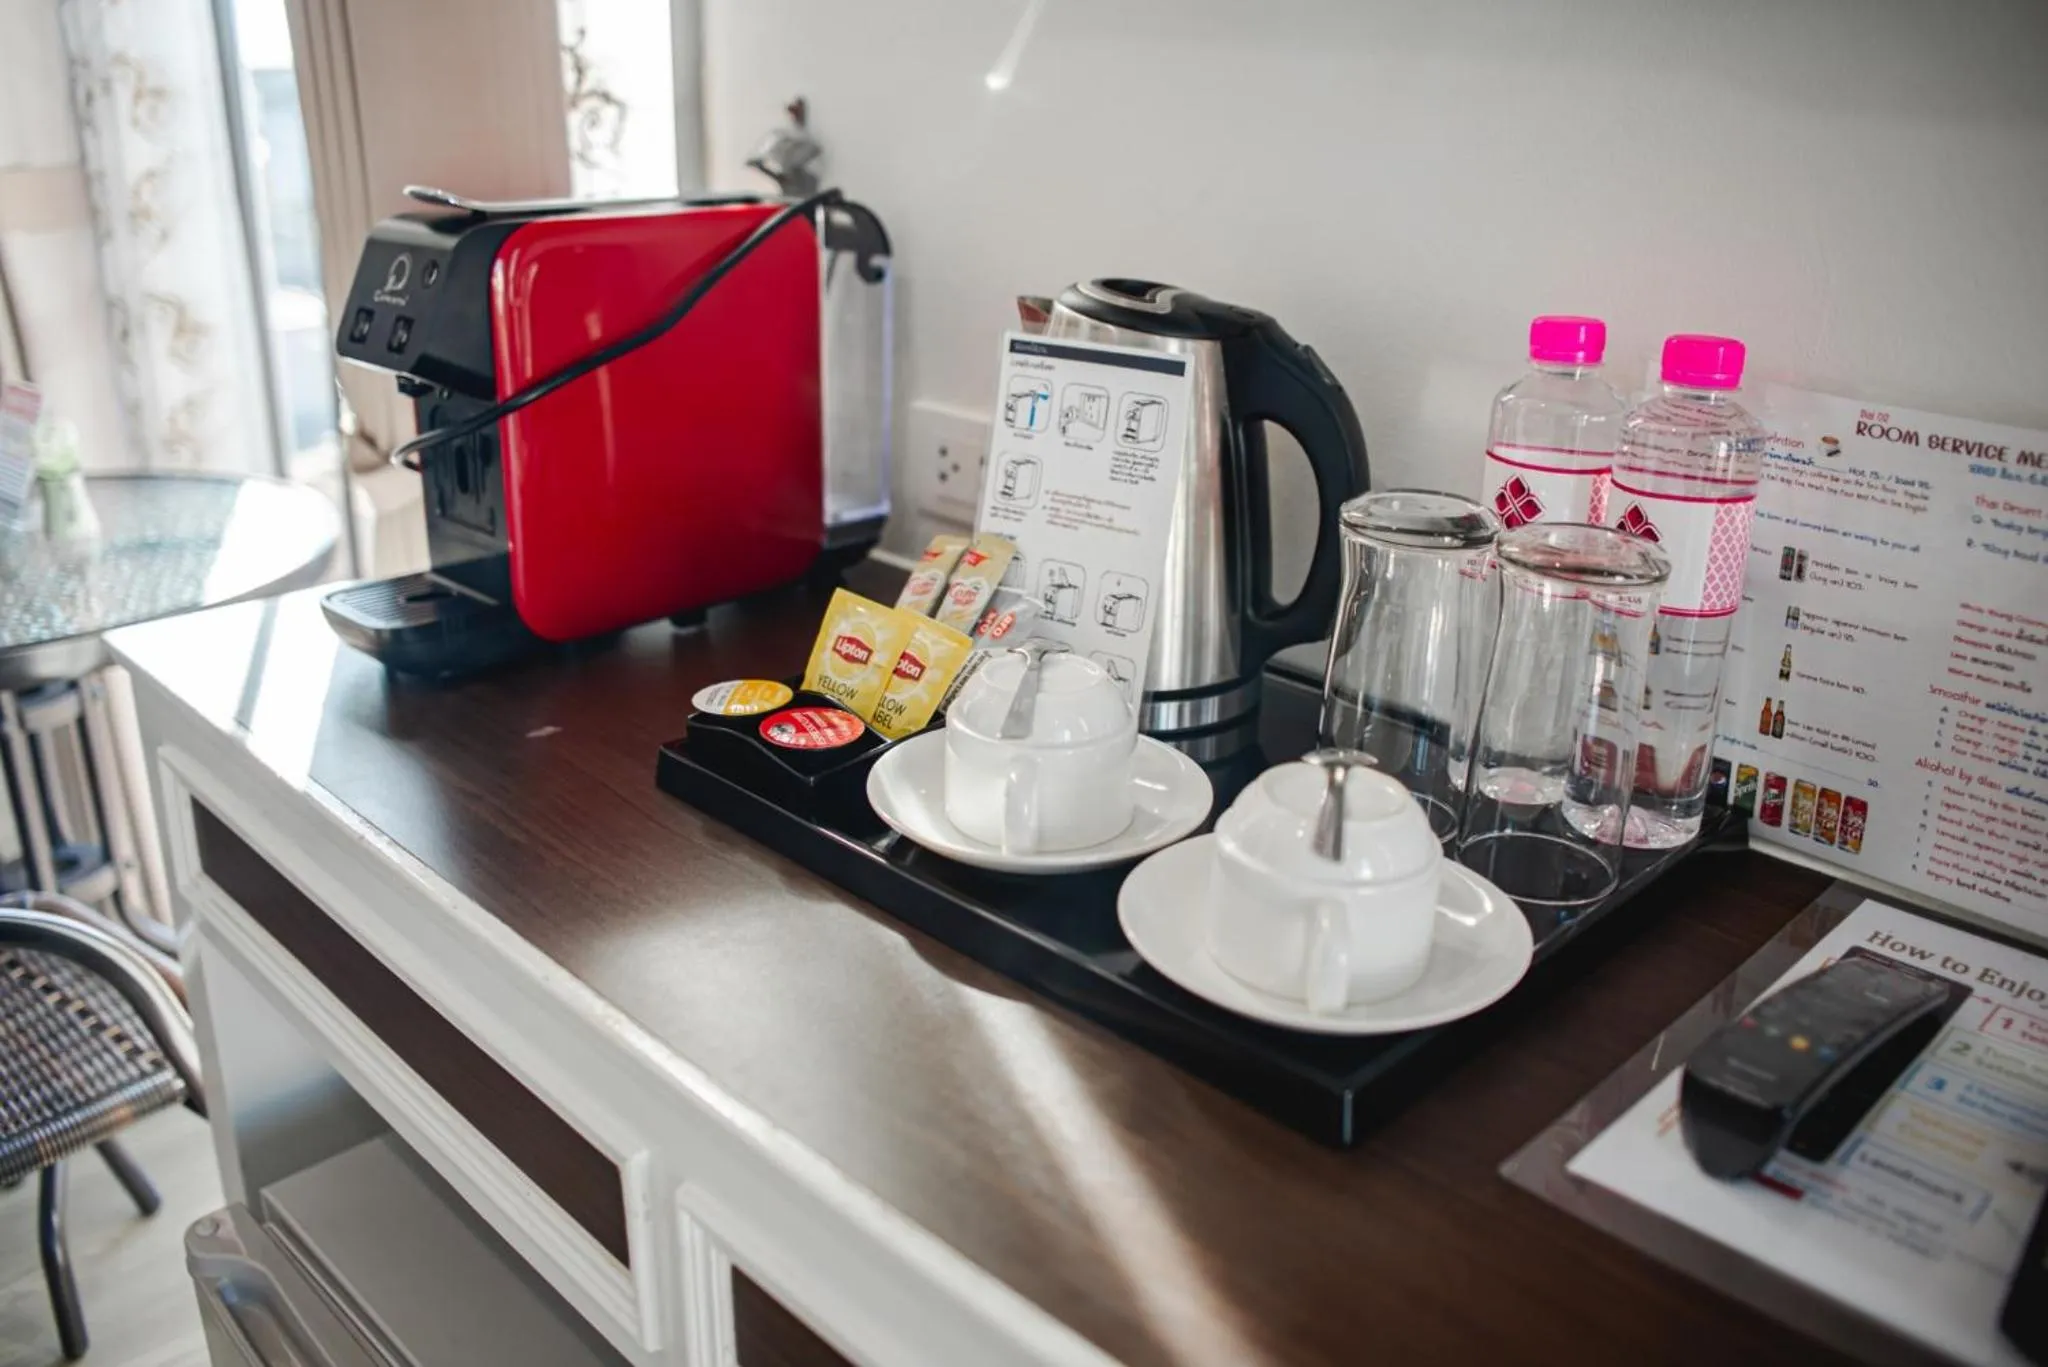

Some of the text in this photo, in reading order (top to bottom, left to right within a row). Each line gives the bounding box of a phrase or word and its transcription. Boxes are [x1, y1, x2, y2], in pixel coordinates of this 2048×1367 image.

[1856, 421, 1919, 447] ROOM
[1928, 434, 2010, 463] SERVICE
[836, 637, 869, 662] Lipton
[816, 674, 858, 700] YELLOW
[1915, 757, 1956, 777] Alcohol
[1958, 768, 1973, 786] by
[1867, 930, 1935, 961] How
[1940, 957, 1970, 976] to
